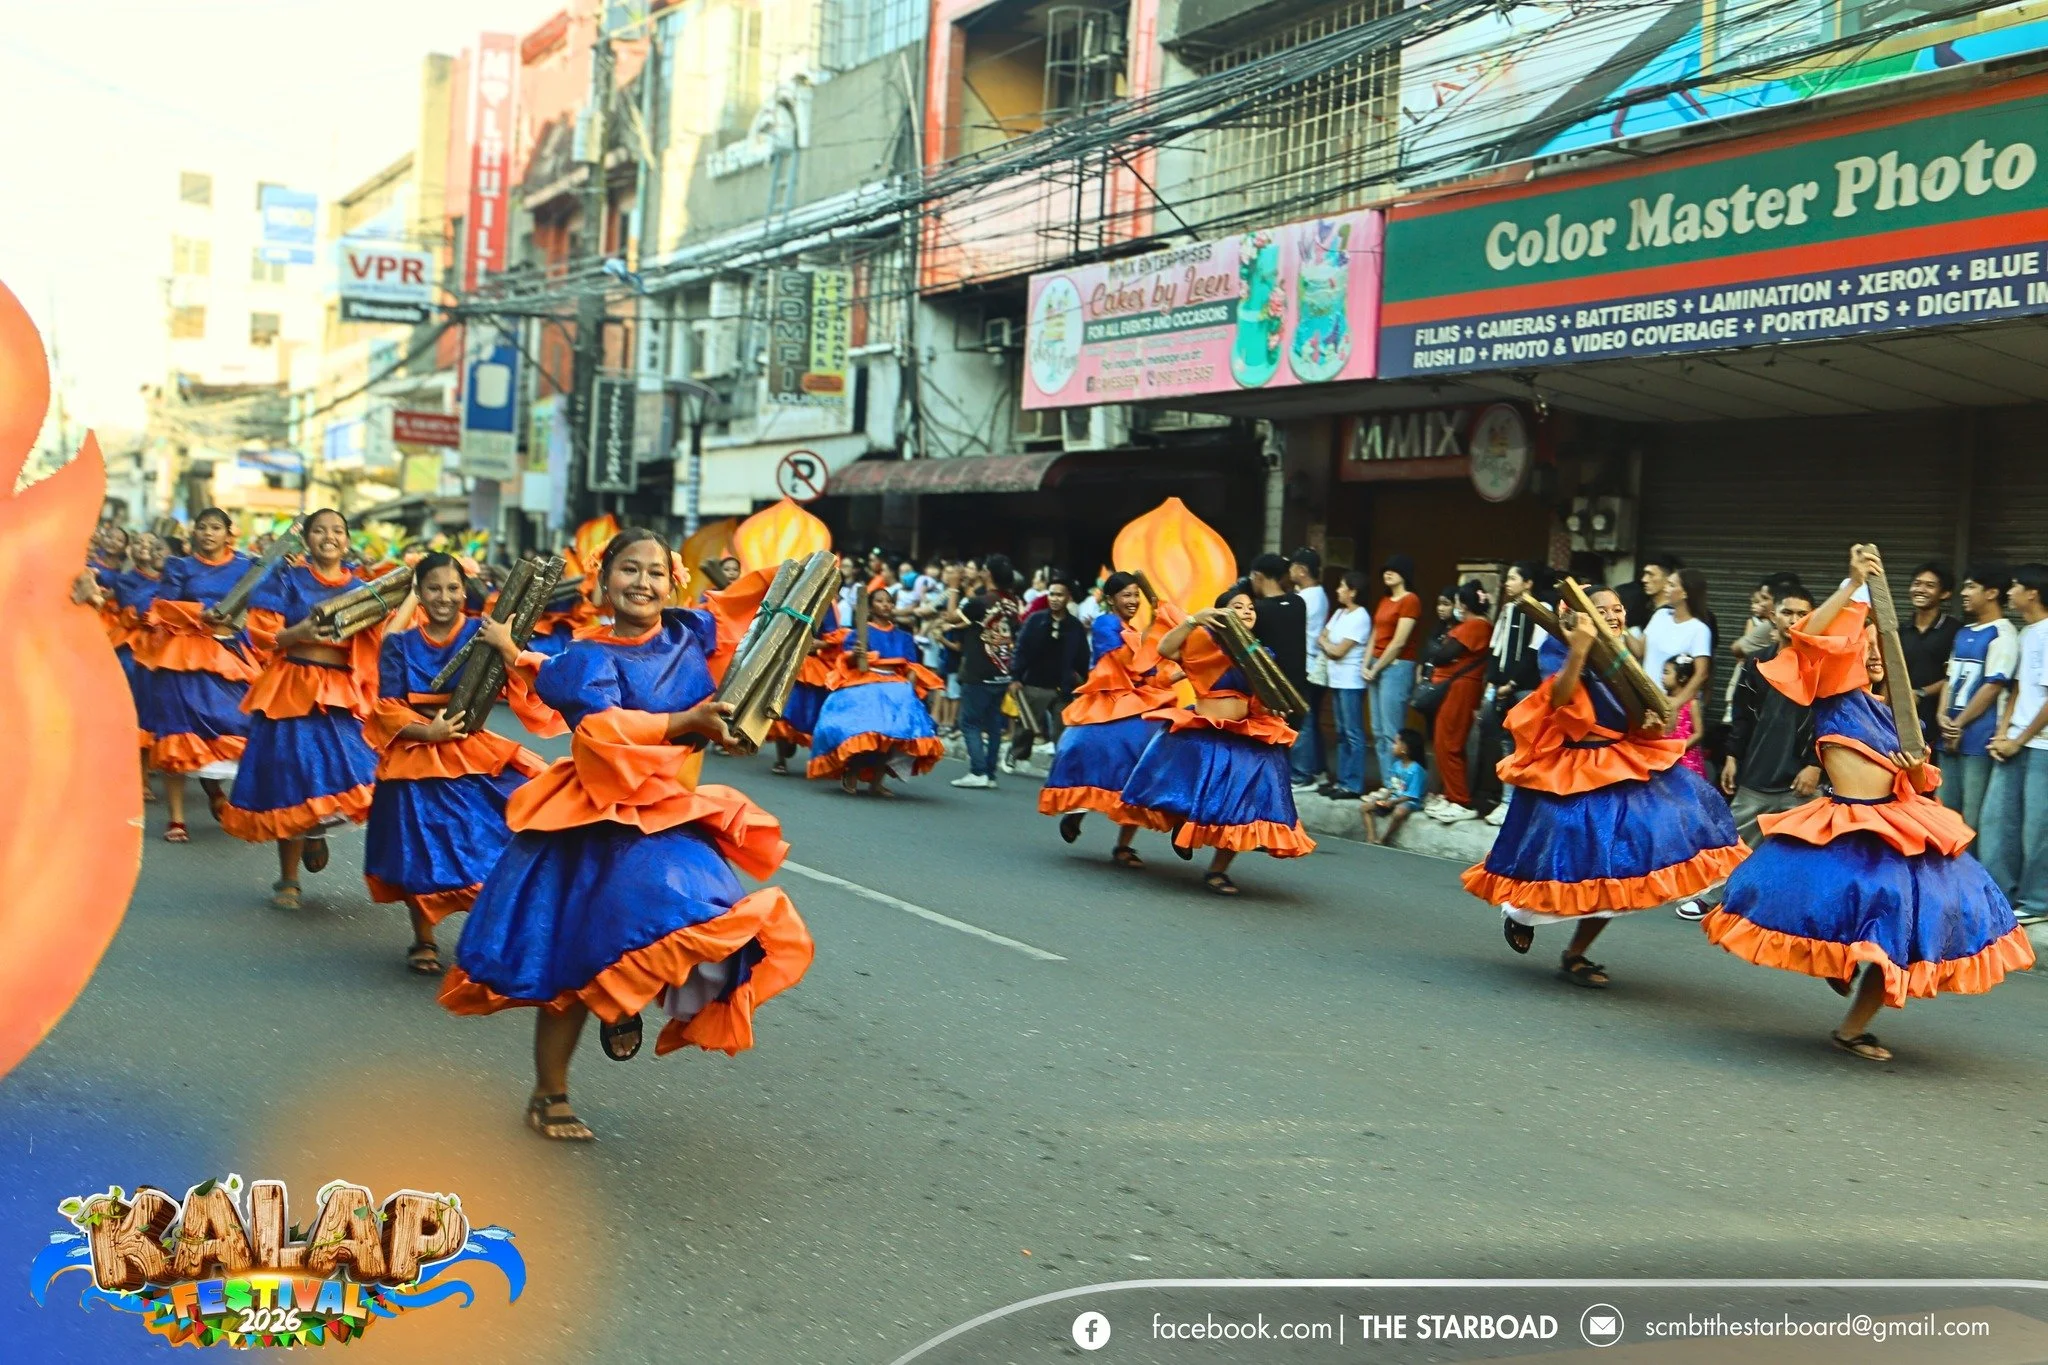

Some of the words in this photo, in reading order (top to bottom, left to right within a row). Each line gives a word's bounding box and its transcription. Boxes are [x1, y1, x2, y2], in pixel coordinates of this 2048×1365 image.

[1485, 214, 1616, 270] Color
[1625, 182, 1819, 251] Master
[1833, 138, 2037, 218] Photo
[348, 252, 425, 285] VPR
[1139, 244, 1213, 275] ENTERPRISES
[1090, 282, 1146, 318] Cakes
[1153, 275, 1178, 316] by
[1415, 323, 1461, 347] FILMS
[1465, 326, 1474, 340] +
[1477, 314, 1556, 340] CAMERAS
[1561, 315, 1571, 328] +
[1575, 298, 1678, 328] BATTERIES
[1682, 299, 1694, 313] +
[1700, 279, 1832, 315] LAMINATION
[1838, 279, 1852, 296] +
[1857, 265, 1942, 296] XEROX
[1947, 265, 1962, 281] +
[1969, 251, 2041, 282] BLUE
[1087, 323, 1105, 341] FOR
[1106, 321, 1120, 337] ALL
[1121, 317, 1151, 336] EVENTS
[1152, 313, 1172, 331] AND
[1173, 304, 1229, 328] OCCASIONS
[1413, 347, 1456, 369] RUSH
[1458, 345, 1474, 365] ID
[1479, 348, 1489, 360] +
[1492, 338, 1549, 362] PHOTO
[1553, 337, 1567, 356] &
[1571, 329, 1627, 354] VIDEO
[1631, 317, 1738, 348] COVERAGE
[1743, 316, 1756, 333] +
[1761, 300, 1890, 334] PORTRAITS
[1896, 300, 1911, 316] +
[1917, 285, 2020, 318] DIGITAL
[1348, 411, 1469, 461] MMIX
